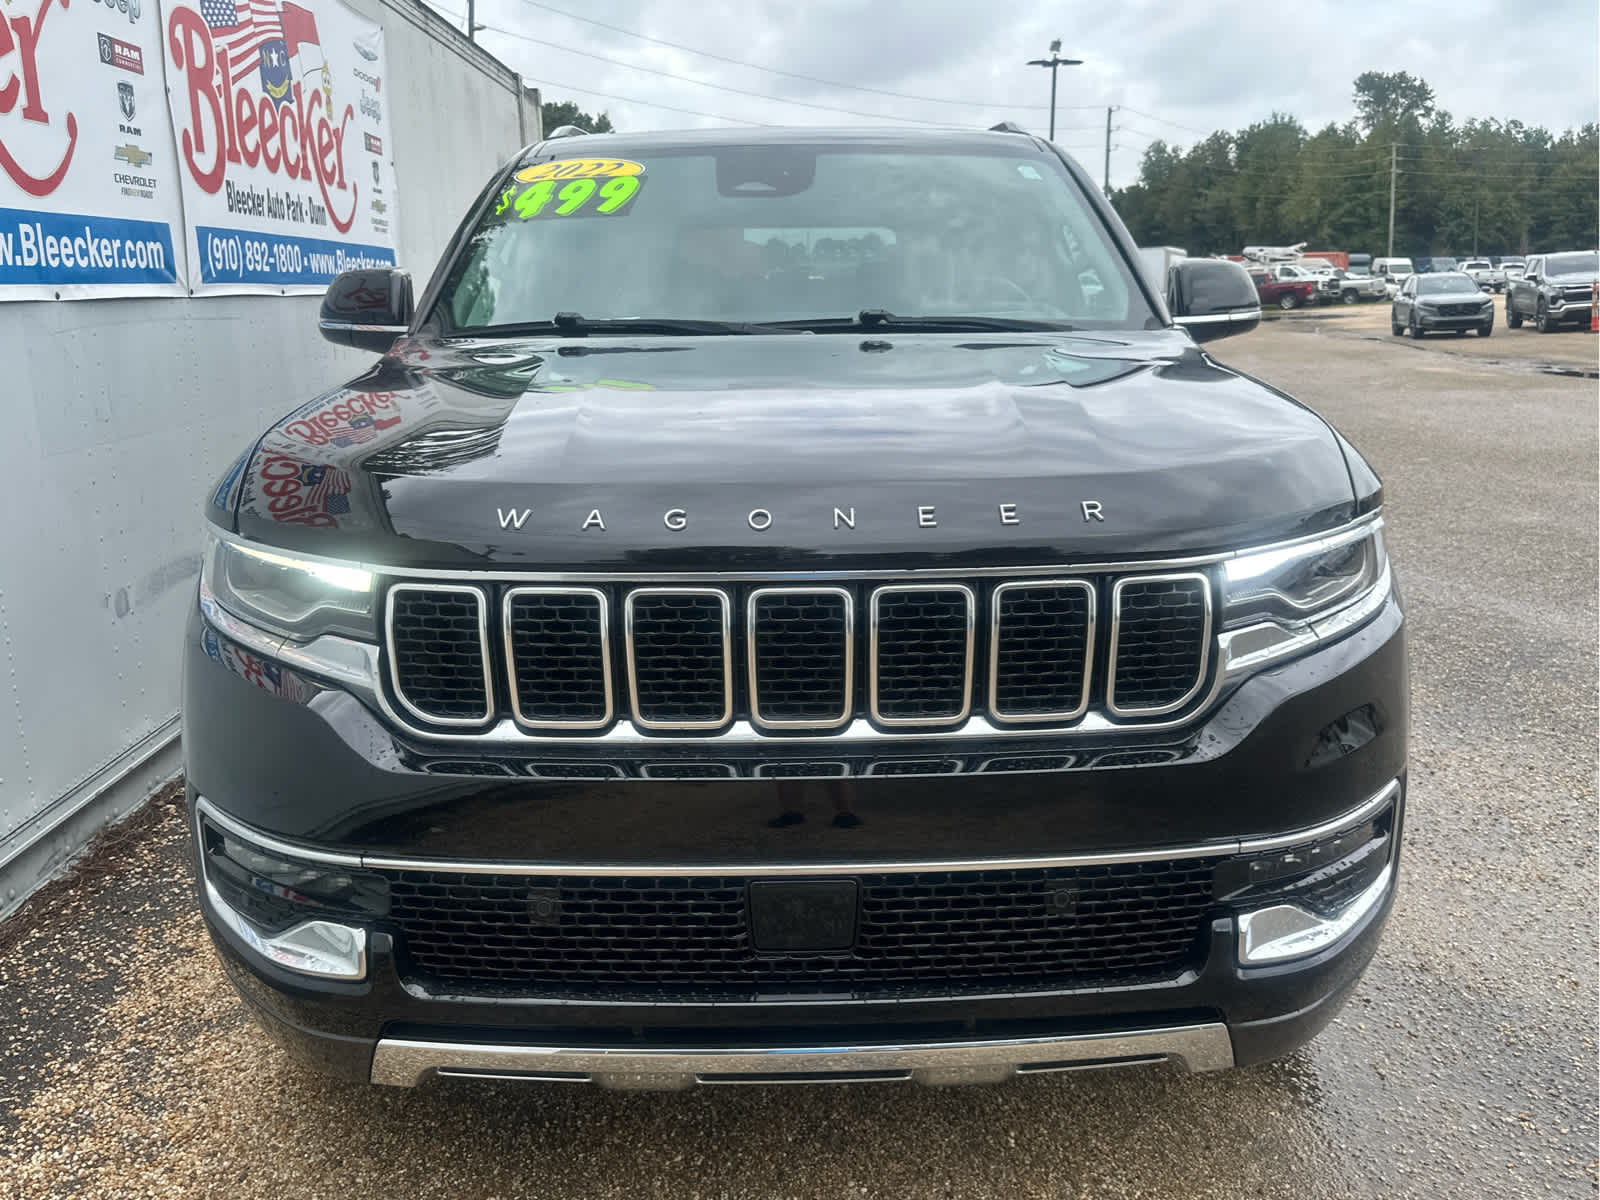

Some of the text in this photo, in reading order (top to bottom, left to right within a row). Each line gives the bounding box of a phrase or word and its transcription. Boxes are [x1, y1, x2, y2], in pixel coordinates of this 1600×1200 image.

[114, 44, 141, 61] RAM
[119, 124, 142, 136] RAM
[168, 6, 357, 234] Bleecker
[114, 173, 157, 188] CHEVROLET
[530, 162, 625, 179] 2022
[225, 179, 265, 217] Bleecker
[267, 188, 285, 220] Auto
[286, 191, 304, 223] Park
[308, 196, 327, 226] Dunn
[208, 232, 243, 278] (910)
[245, 239, 302, 273] 892-1800
[309, 248, 392, 275] www.Bleeckercom
[496, 500, 1105, 532] WAGONEER
